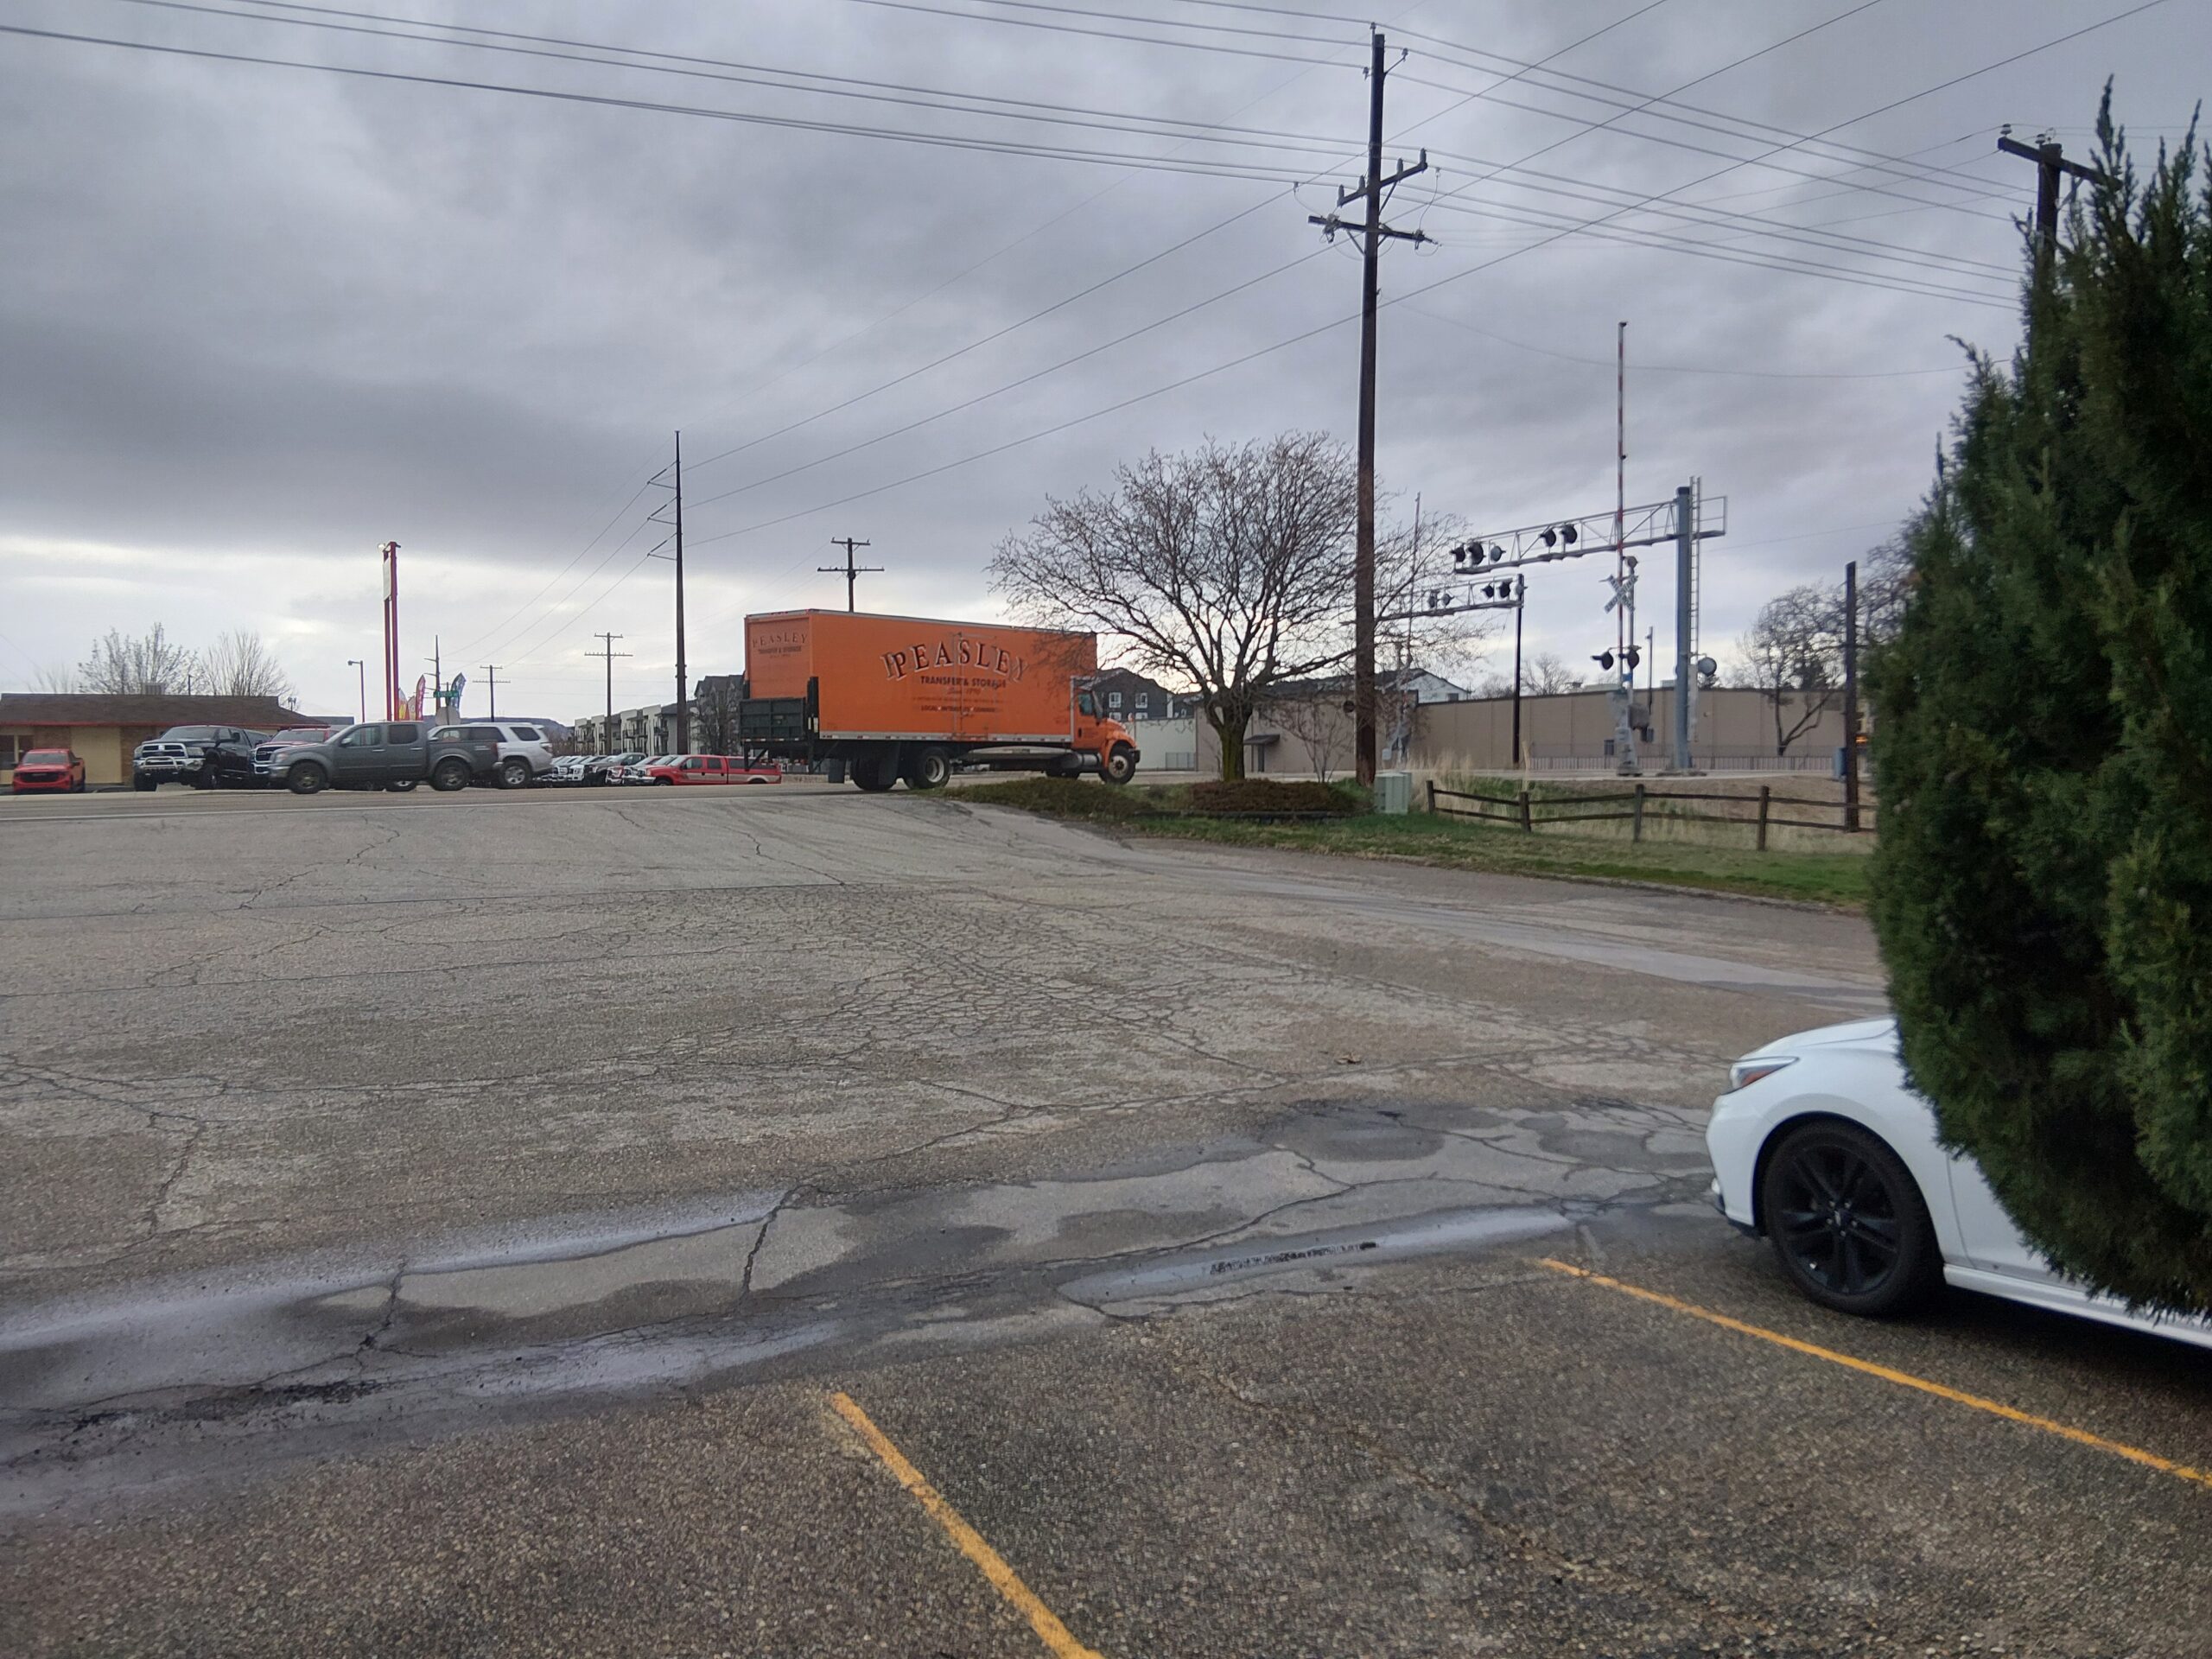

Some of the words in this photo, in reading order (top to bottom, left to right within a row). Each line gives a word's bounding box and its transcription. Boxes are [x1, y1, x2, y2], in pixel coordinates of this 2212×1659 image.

[753, 632, 808, 648] PEASLEY
[880, 639, 1029, 683] PEASLEY
[920, 676, 962, 686] TRANSFER
[963, 677, 969, 686] &
